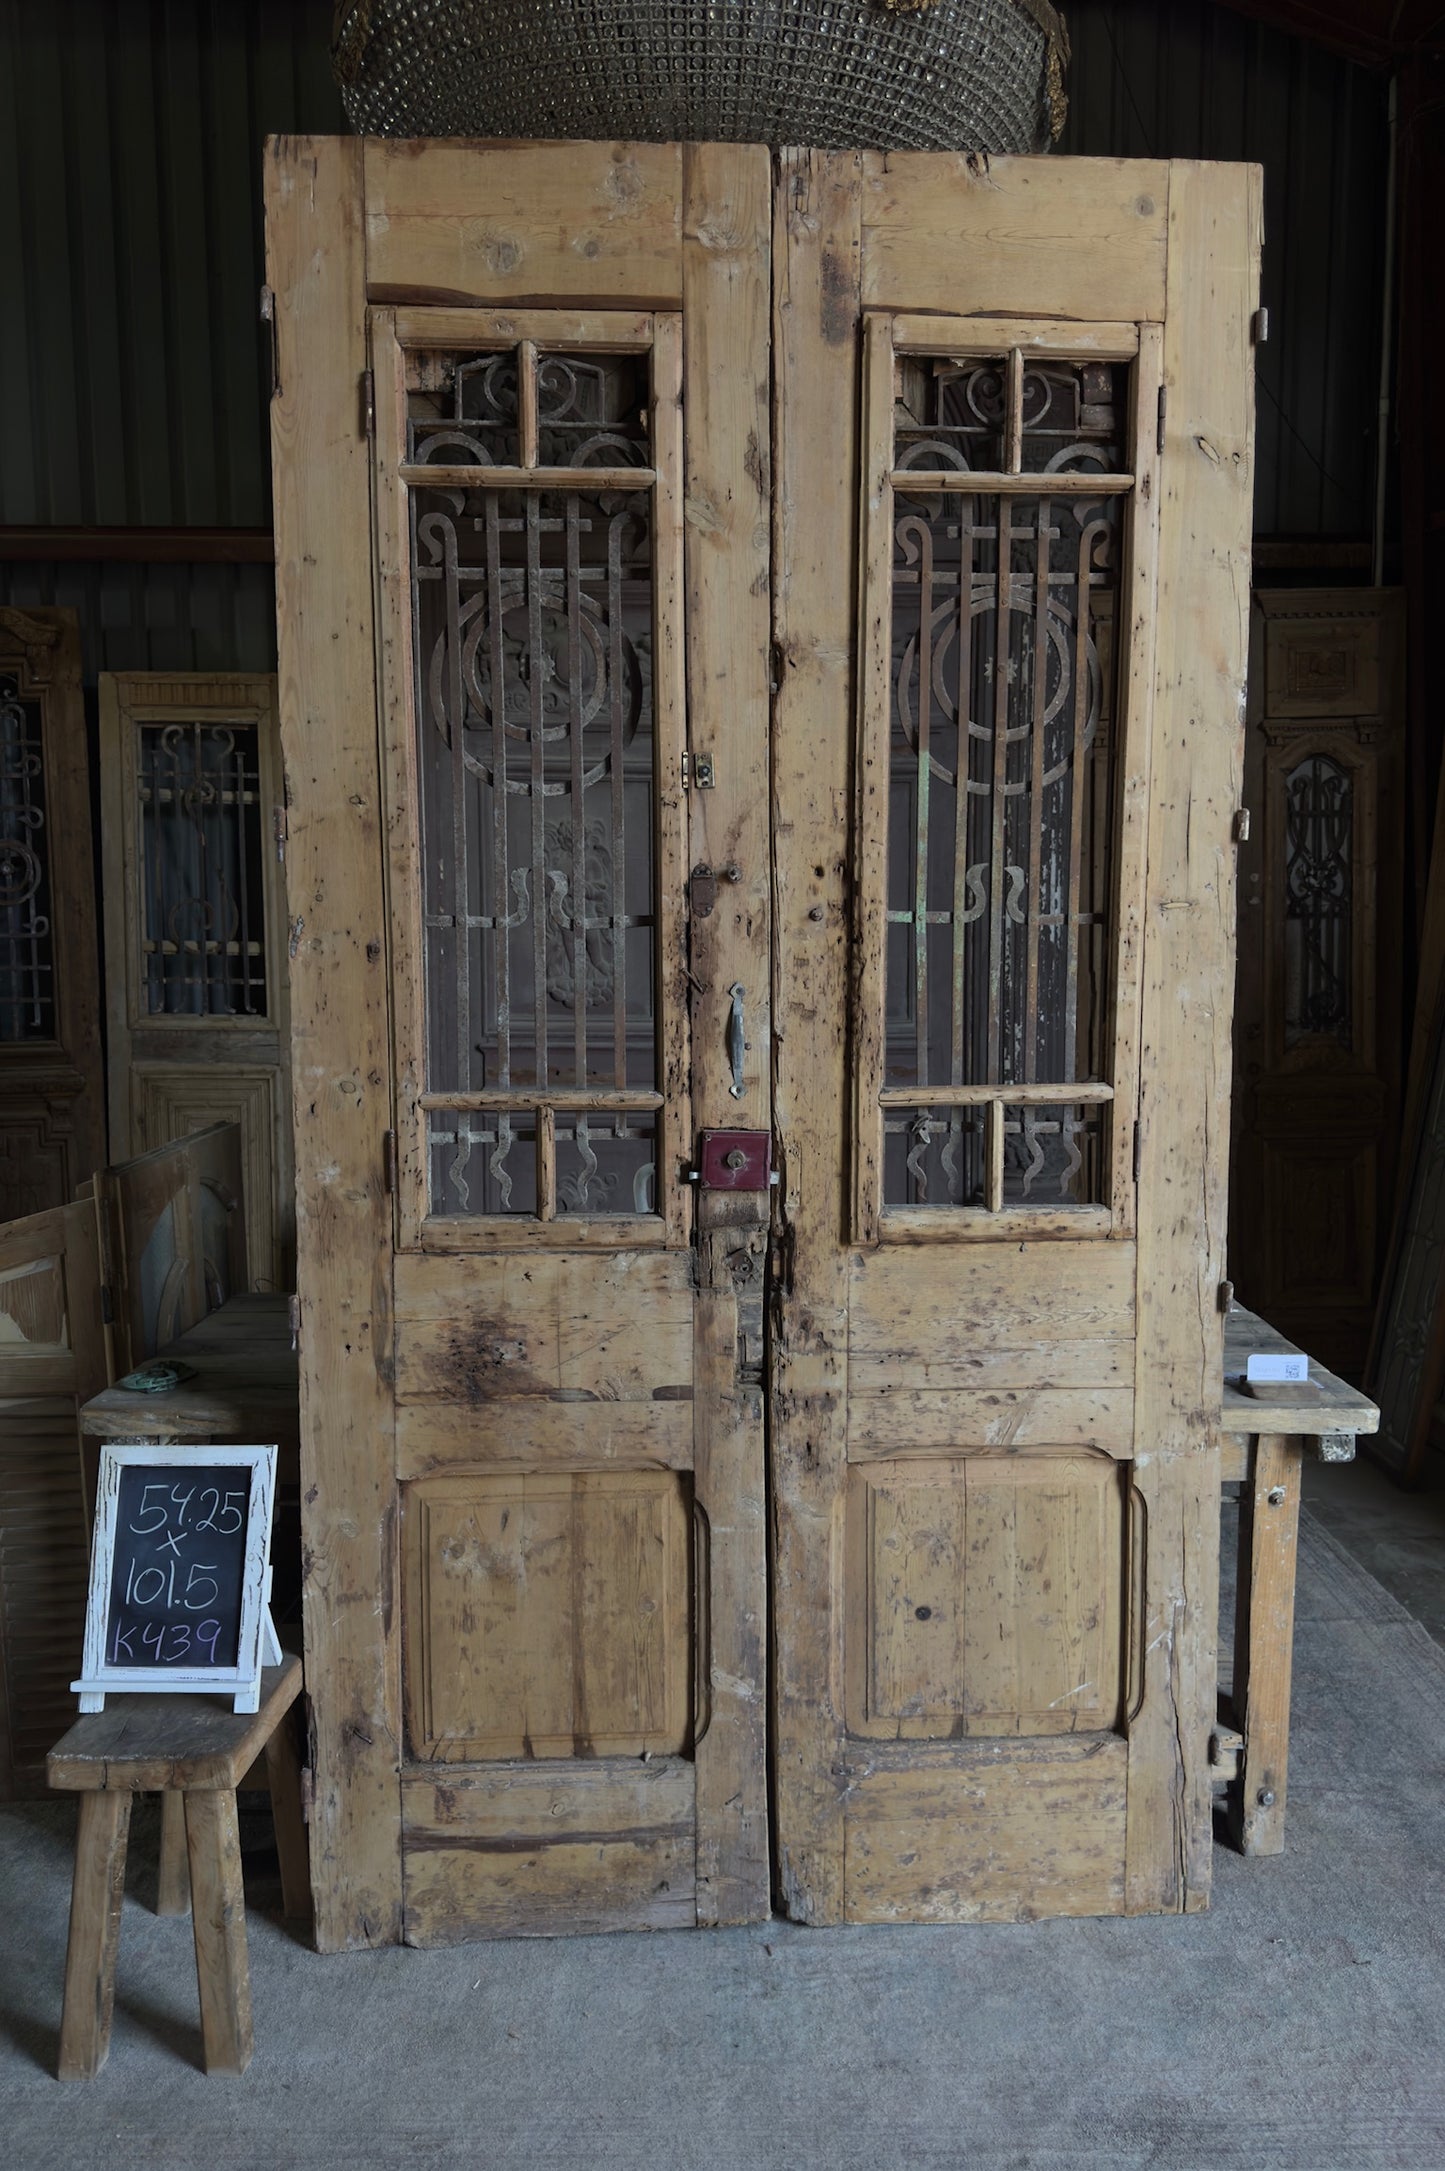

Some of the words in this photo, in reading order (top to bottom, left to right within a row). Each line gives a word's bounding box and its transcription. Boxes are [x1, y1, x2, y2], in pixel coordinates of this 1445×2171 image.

[130, 1482, 245, 1534] 54.25
[125, 1557, 218, 1610] 101.5
[113, 1617, 222, 1663] K439
